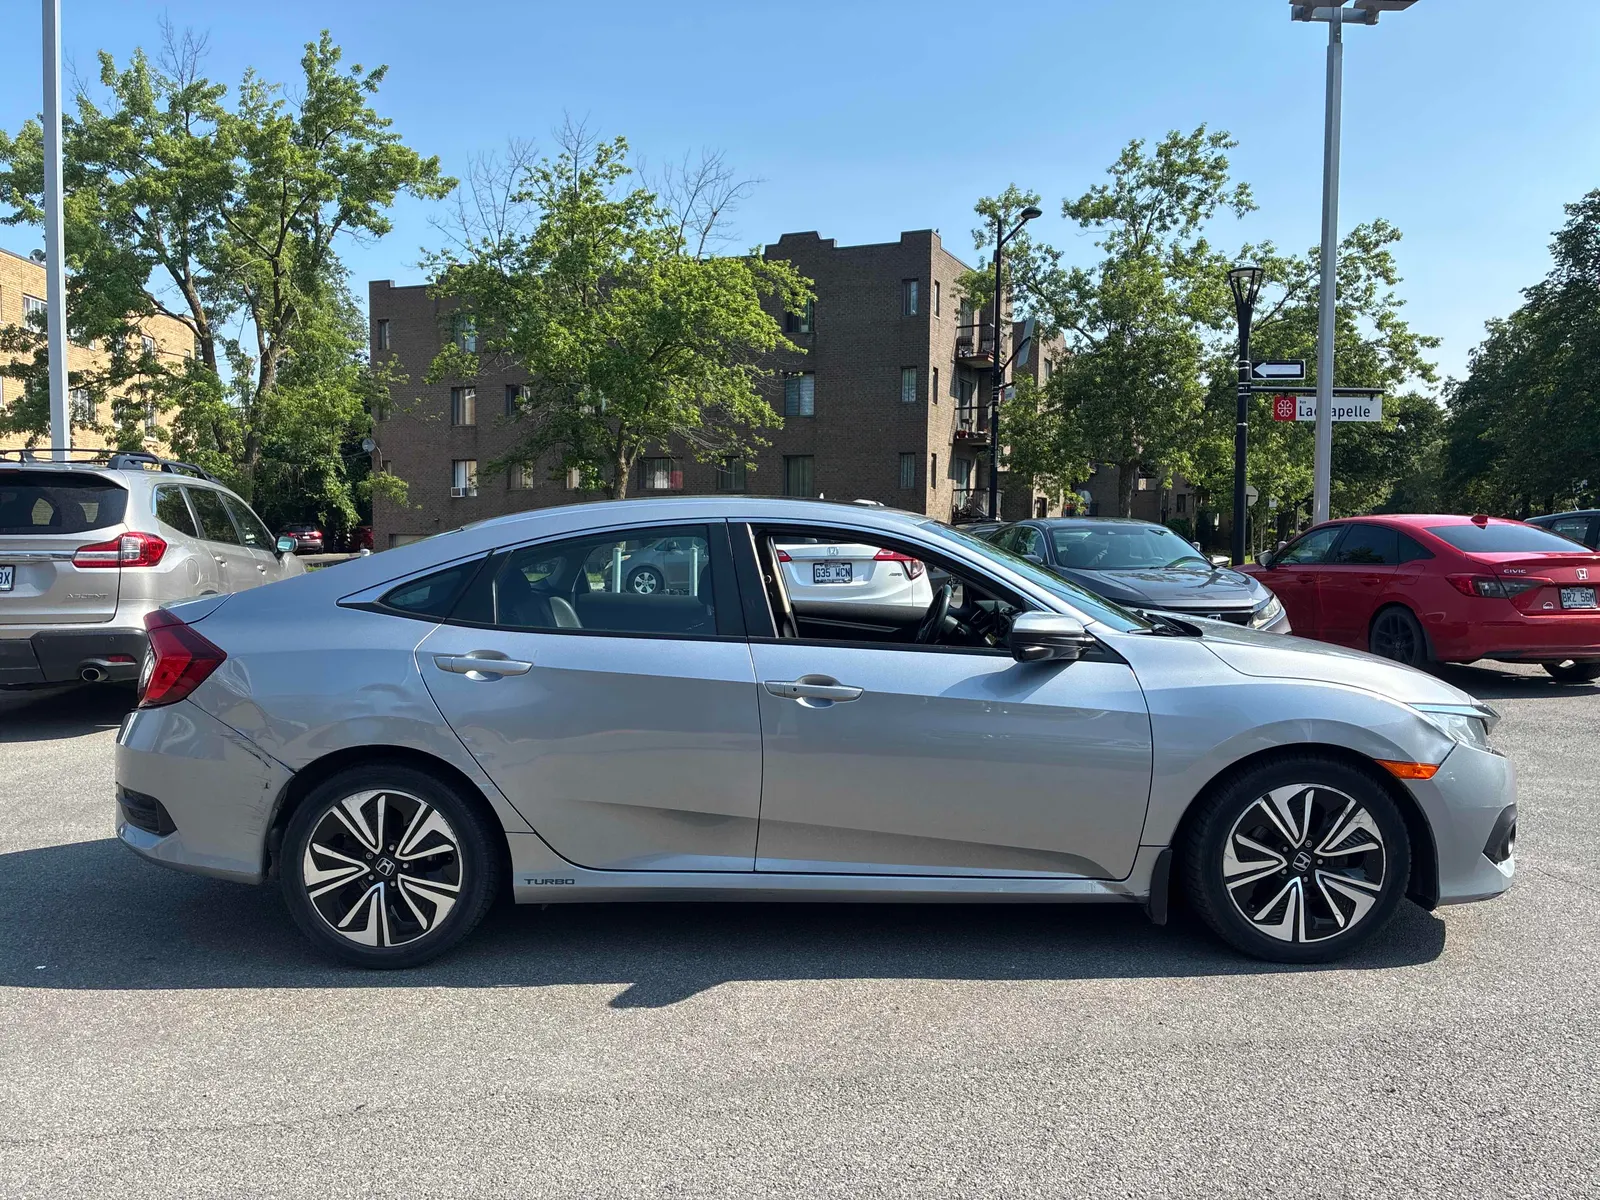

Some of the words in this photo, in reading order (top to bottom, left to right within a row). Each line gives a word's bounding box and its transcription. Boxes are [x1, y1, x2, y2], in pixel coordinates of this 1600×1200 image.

[1299, 405, 1371, 420] Laapelle
[815, 567, 831, 578] G35
[1562, 592, 1576, 602] BRZ
